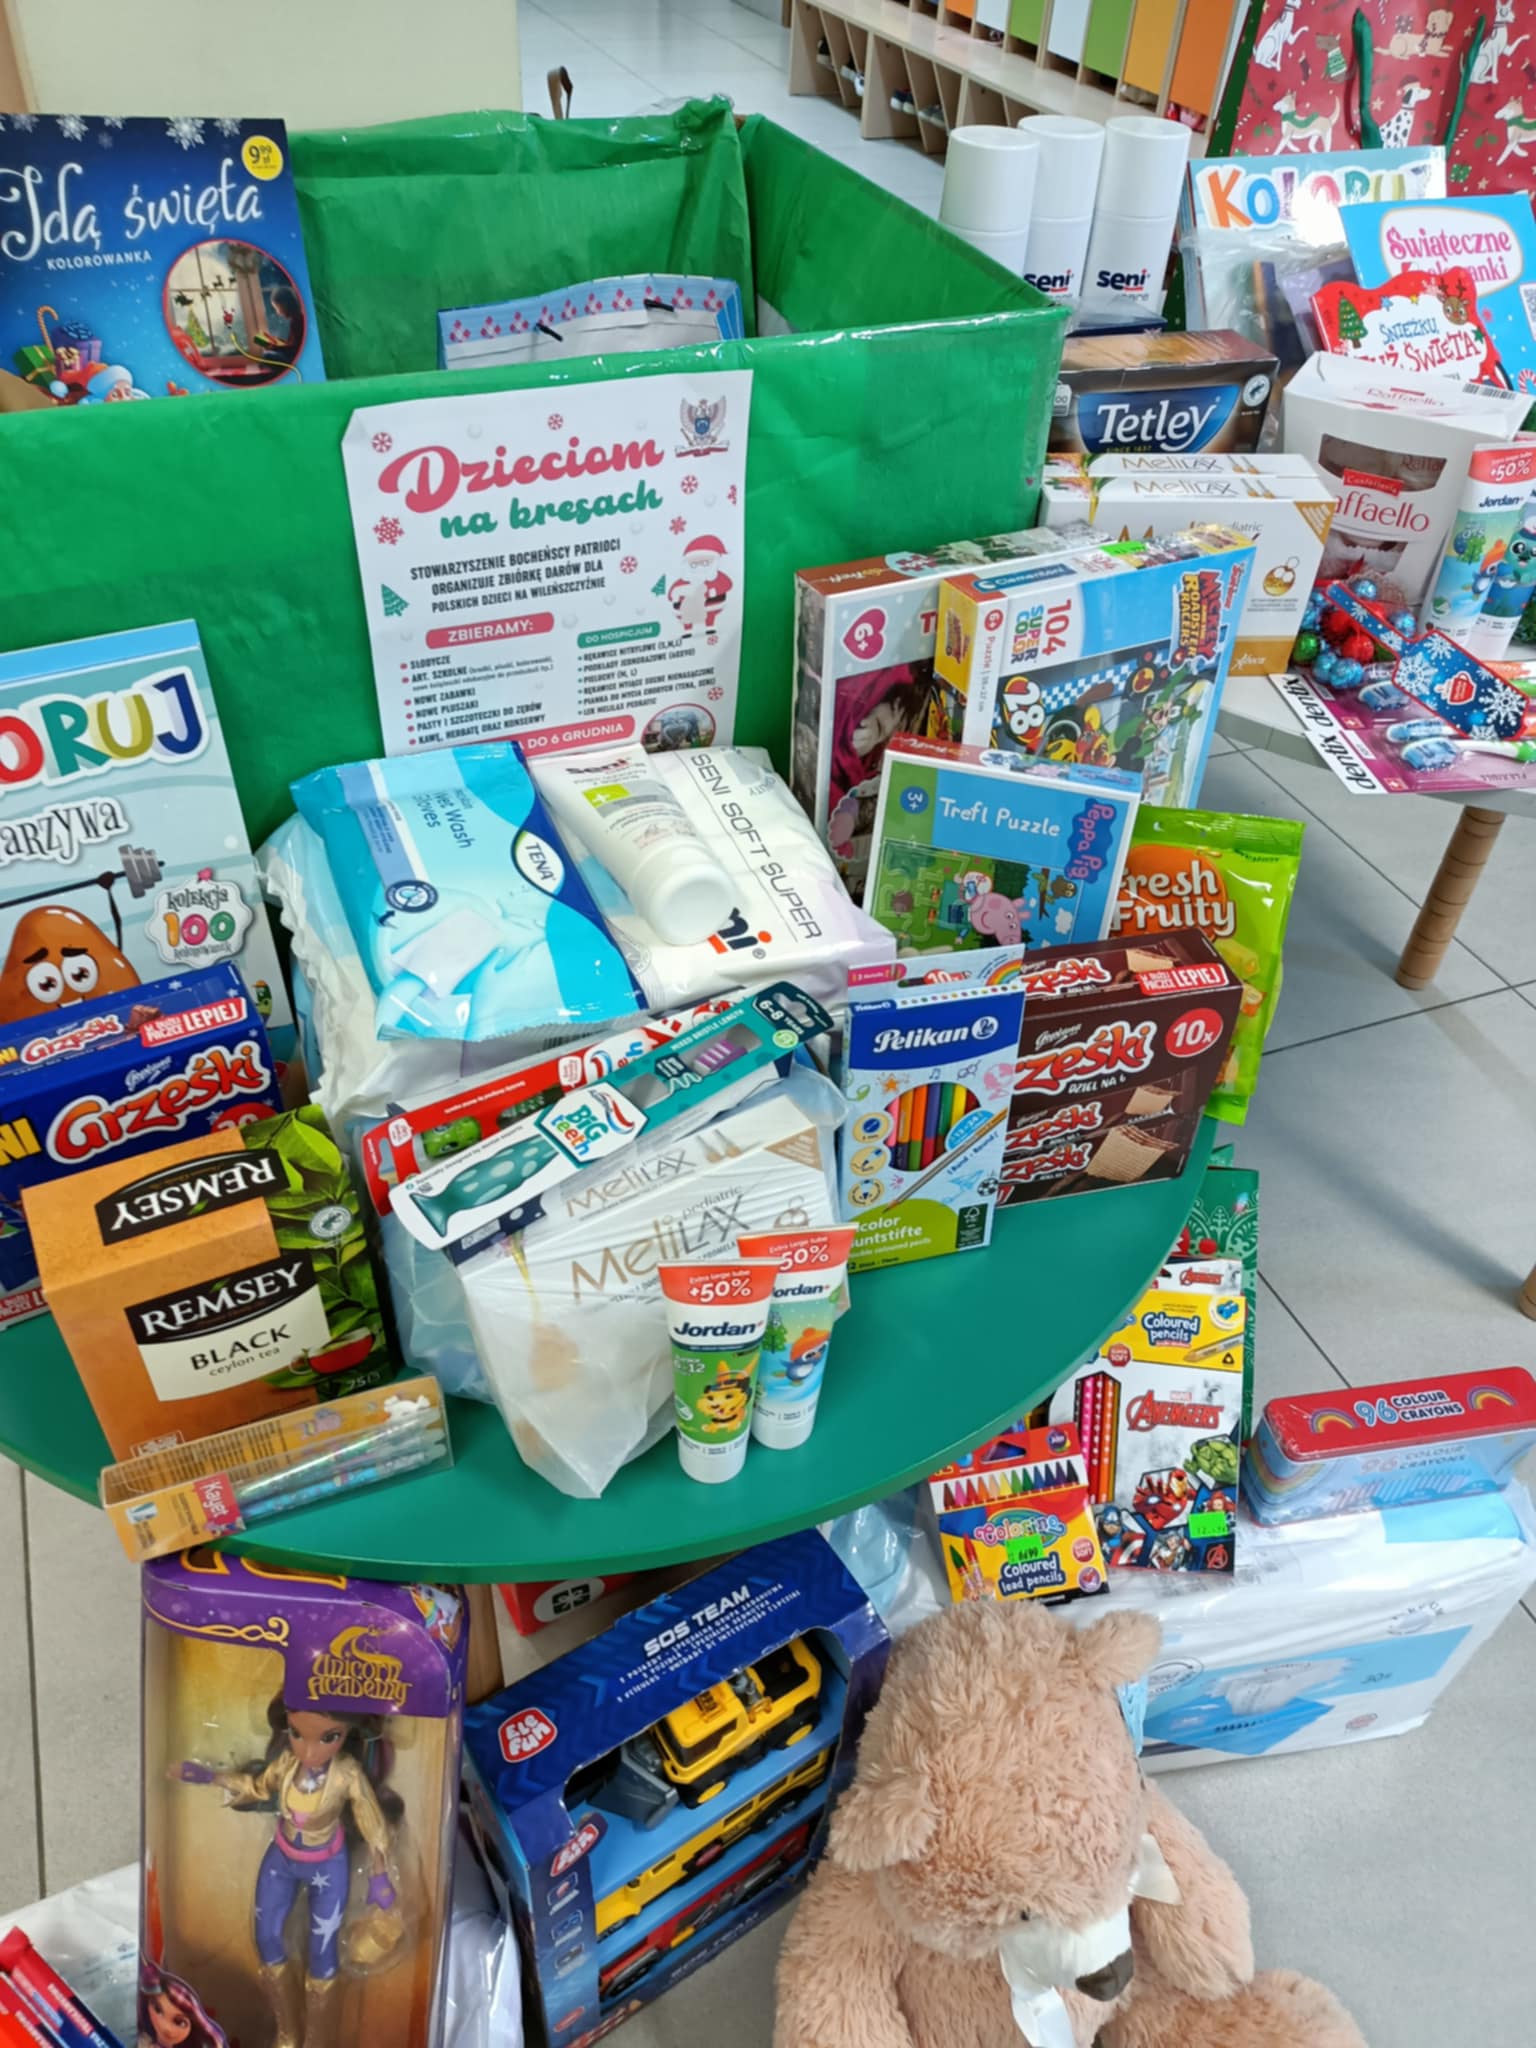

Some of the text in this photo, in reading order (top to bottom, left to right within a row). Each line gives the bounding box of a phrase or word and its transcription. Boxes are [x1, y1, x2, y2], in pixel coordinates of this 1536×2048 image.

[124, 158, 263, 241] święta
[46, 250, 152, 271] KOLOROWANKA
[1386, 227, 1512, 261] Świąteczne
[1097, 399, 1216, 453] Tetley
[377, 436, 665, 514] Dzieciom
[440, 479, 663, 539] na kresach
[1479, 496, 1520, 508] Jordan
[410, 538, 621, 581] STOWARZYSZENIE BOCHEŃSCY PATRIOCI
[431, 559, 604, 596] ORGANIZUJE ZBIÓRKĘ DARÓW DLA
[432, 577, 607, 614] POLSKICH DZIECI NA WILEŃSZCZYŹNIE
[447, 619, 534, 643] ZBIERAMY:
[1042, 599, 1072, 656] 104
[1180, 592, 1191, 647] RACERS
[1183, 574, 1200, 657] ROADSTER
[1197, 571, 1221, 659] MICKEY
[585, 627, 653, 644] DO HOSPICJUM
[854, 622, 874, 651] 6+
[1011, 610, 1030, 664] COLOR
[1025, 604, 1044, 662] SUPER
[410, 655, 451, 670] SŁODYCZE
[620, 653, 667, 667] JEDNORAZOWE
[983, 636, 996, 668] Puzzle
[411, 666, 468, 683] ART. SZKOLNE
[583, 672, 616, 684] PIELUCHY
[413, 687, 476, 705] NOWE ZABAWKI
[415, 700, 479, 719] NOWE PLUSZAKI
[583, 695, 609, 706] PIANKA
[1003, 681, 1046, 736] 28
[1284, 676, 1334, 729] dentix
[416, 700, 543, 732] PASTY SZCZOTECZKI DO ZĘBÓW
[418, 714, 546, 745] KAWĘ, HERBATĘ ORAZ KONSERWY
[527, 736, 548, 749] DO
[551, 735, 560, 744] 6
[562, 723, 624, 743] GRUDNIA
[1320, 733, 1377, 791] dentix
[907, 792, 923, 811] 3+
[939, 796, 1062, 837] Trefl Puzzle
[446, 803, 474, 849] Wash
[1067, 803, 1114, 881] Peppa Pig
[526, 842, 554, 882] TENA
[692, 752, 732, 796] SENI
[721, 801, 771, 857] SOFT
[760, 861, 823, 940] SUPER
[167, 885, 229, 912] kolekcja
[163, 911, 236, 948] 100
[1111, 897, 1236, 937] Fruity
[1173, 966, 1222, 989] LEPIEJ
[182, 1002, 239, 1032] LEPIEJ
[759, 1000, 785, 1021] 6-8
[23, 1014, 121, 1063] Grześki
[873, 1025, 969, 1053] Pelikan
[1172, 1019, 1212, 1049] 10x
[54, 1042, 266, 1160] Grześki
[1068, 1078, 1118, 1095] DZIEL NA
[551, 1114, 590, 1157] teeth
[566, 1104, 609, 1142] BiG
[109, 1157, 277, 1232] REMSEY
[567, 1149, 697, 1217] MeliLAX
[683, 1184, 744, 1222] pediatric
[572, 1193, 751, 1306] MeliLAX
[852, 1225, 923, 1248] untstifte
[140, 1261, 303, 1337] REMSEY
[689, 1278, 752, 1303] +50%
[673, 1320, 756, 1337] Jordan
[1143, 1314, 1199, 1332] Coloured
[1150, 1328, 1189, 1343] pencils
[190, 1324, 291, 1371] BLACK
[209, 1346, 281, 1377] ceylon tea
[1126, 1390, 1224, 1432] AVENGERS
[1356, 1391, 1447, 1426] 96 COLOUR
[1401, 1403, 1464, 1422] CRAYONS
[203, 1479, 230, 1518] Kayet
[975, 1514, 1067, 1546] Colorino
[1002, 1572, 1064, 1593] lead pencils
[1003, 1555, 1058, 1578] Coloured
[643, 1585, 751, 1658] SOS TEAM
[312, 1650, 403, 1680] Unicorn
[306, 1676, 413, 1708] Academy
